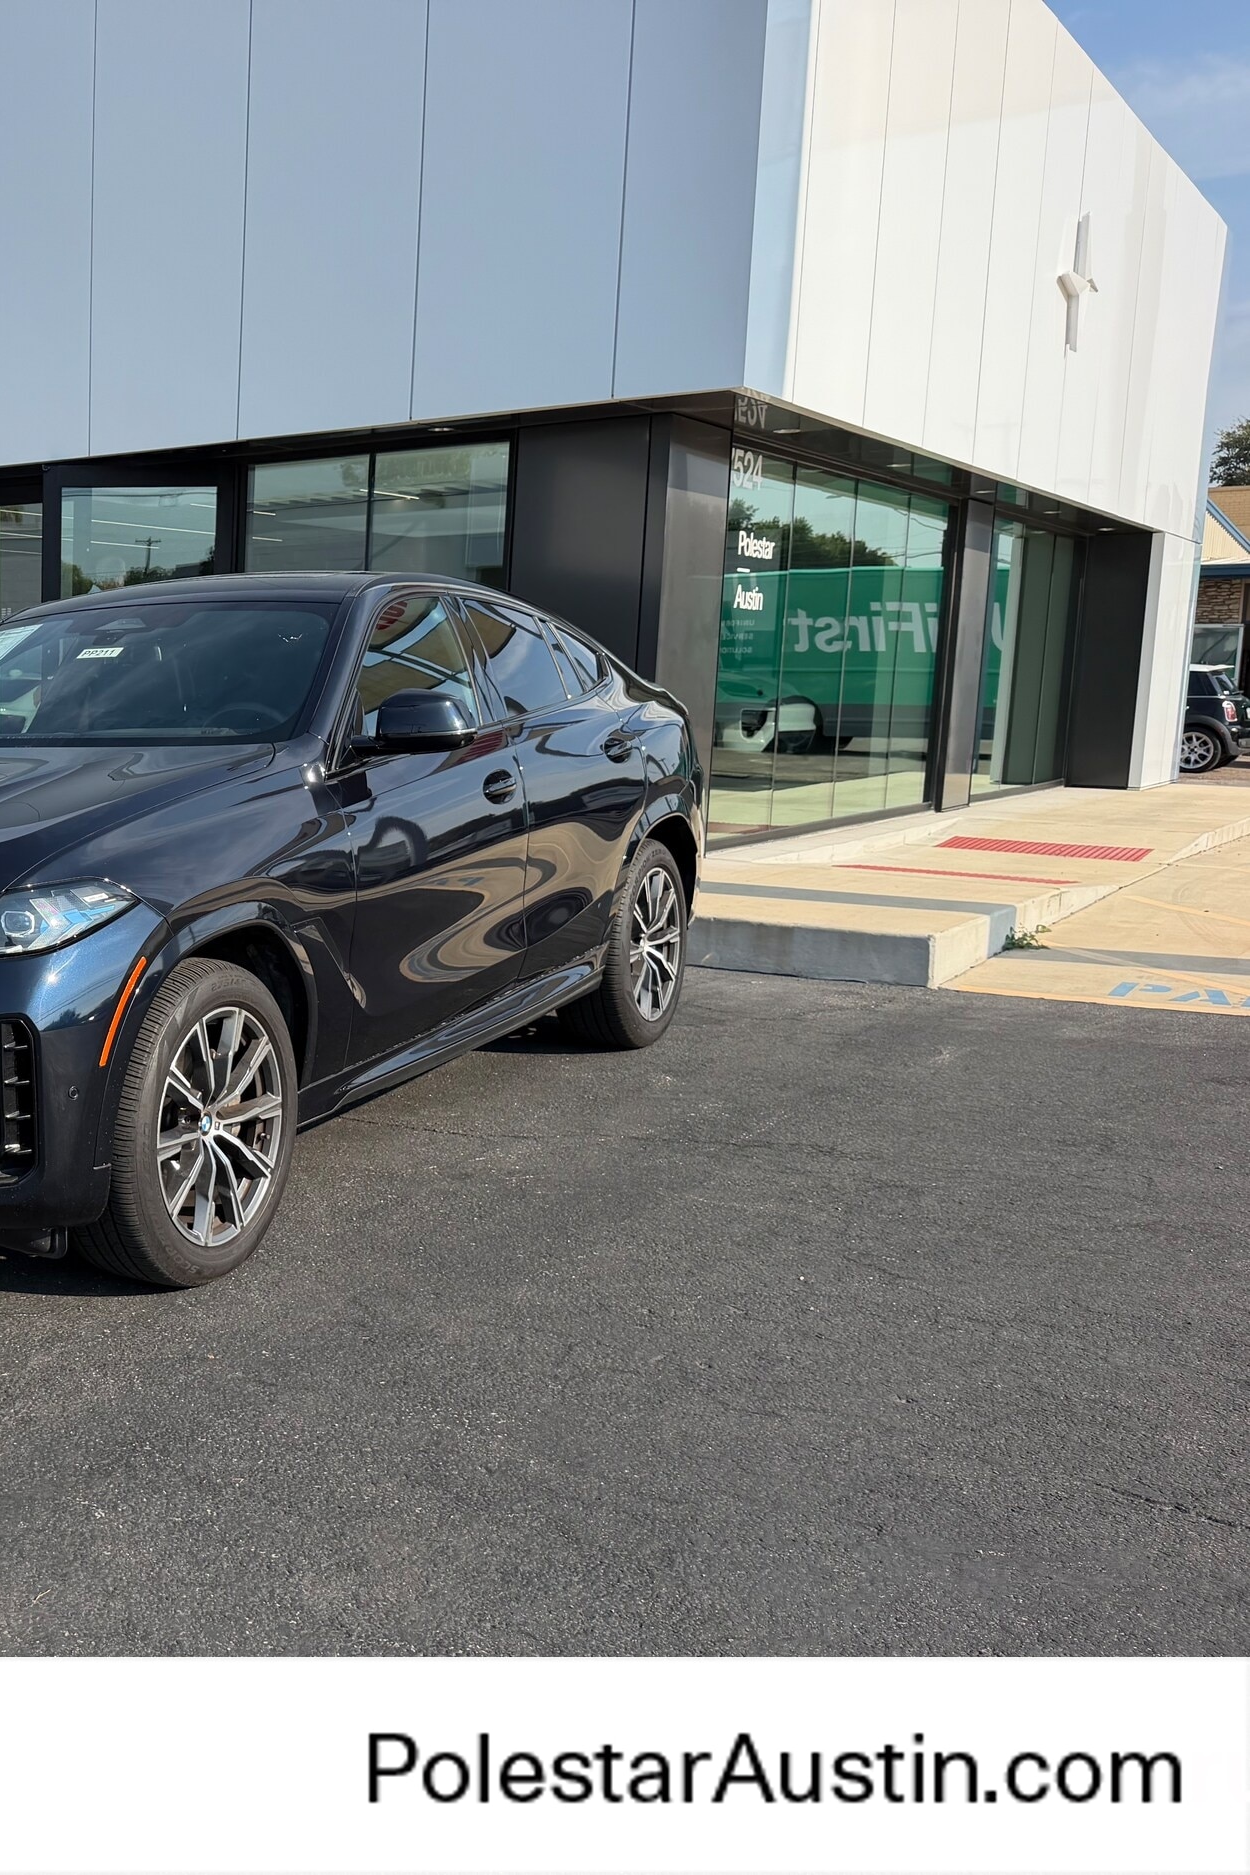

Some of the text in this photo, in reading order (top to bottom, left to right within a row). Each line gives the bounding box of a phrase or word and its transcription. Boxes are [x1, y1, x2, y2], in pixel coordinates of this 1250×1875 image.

[738, 530, 775, 559] Polestar
[733, 584, 763, 611] Austin
[81, 649, 116, 657] PP211
